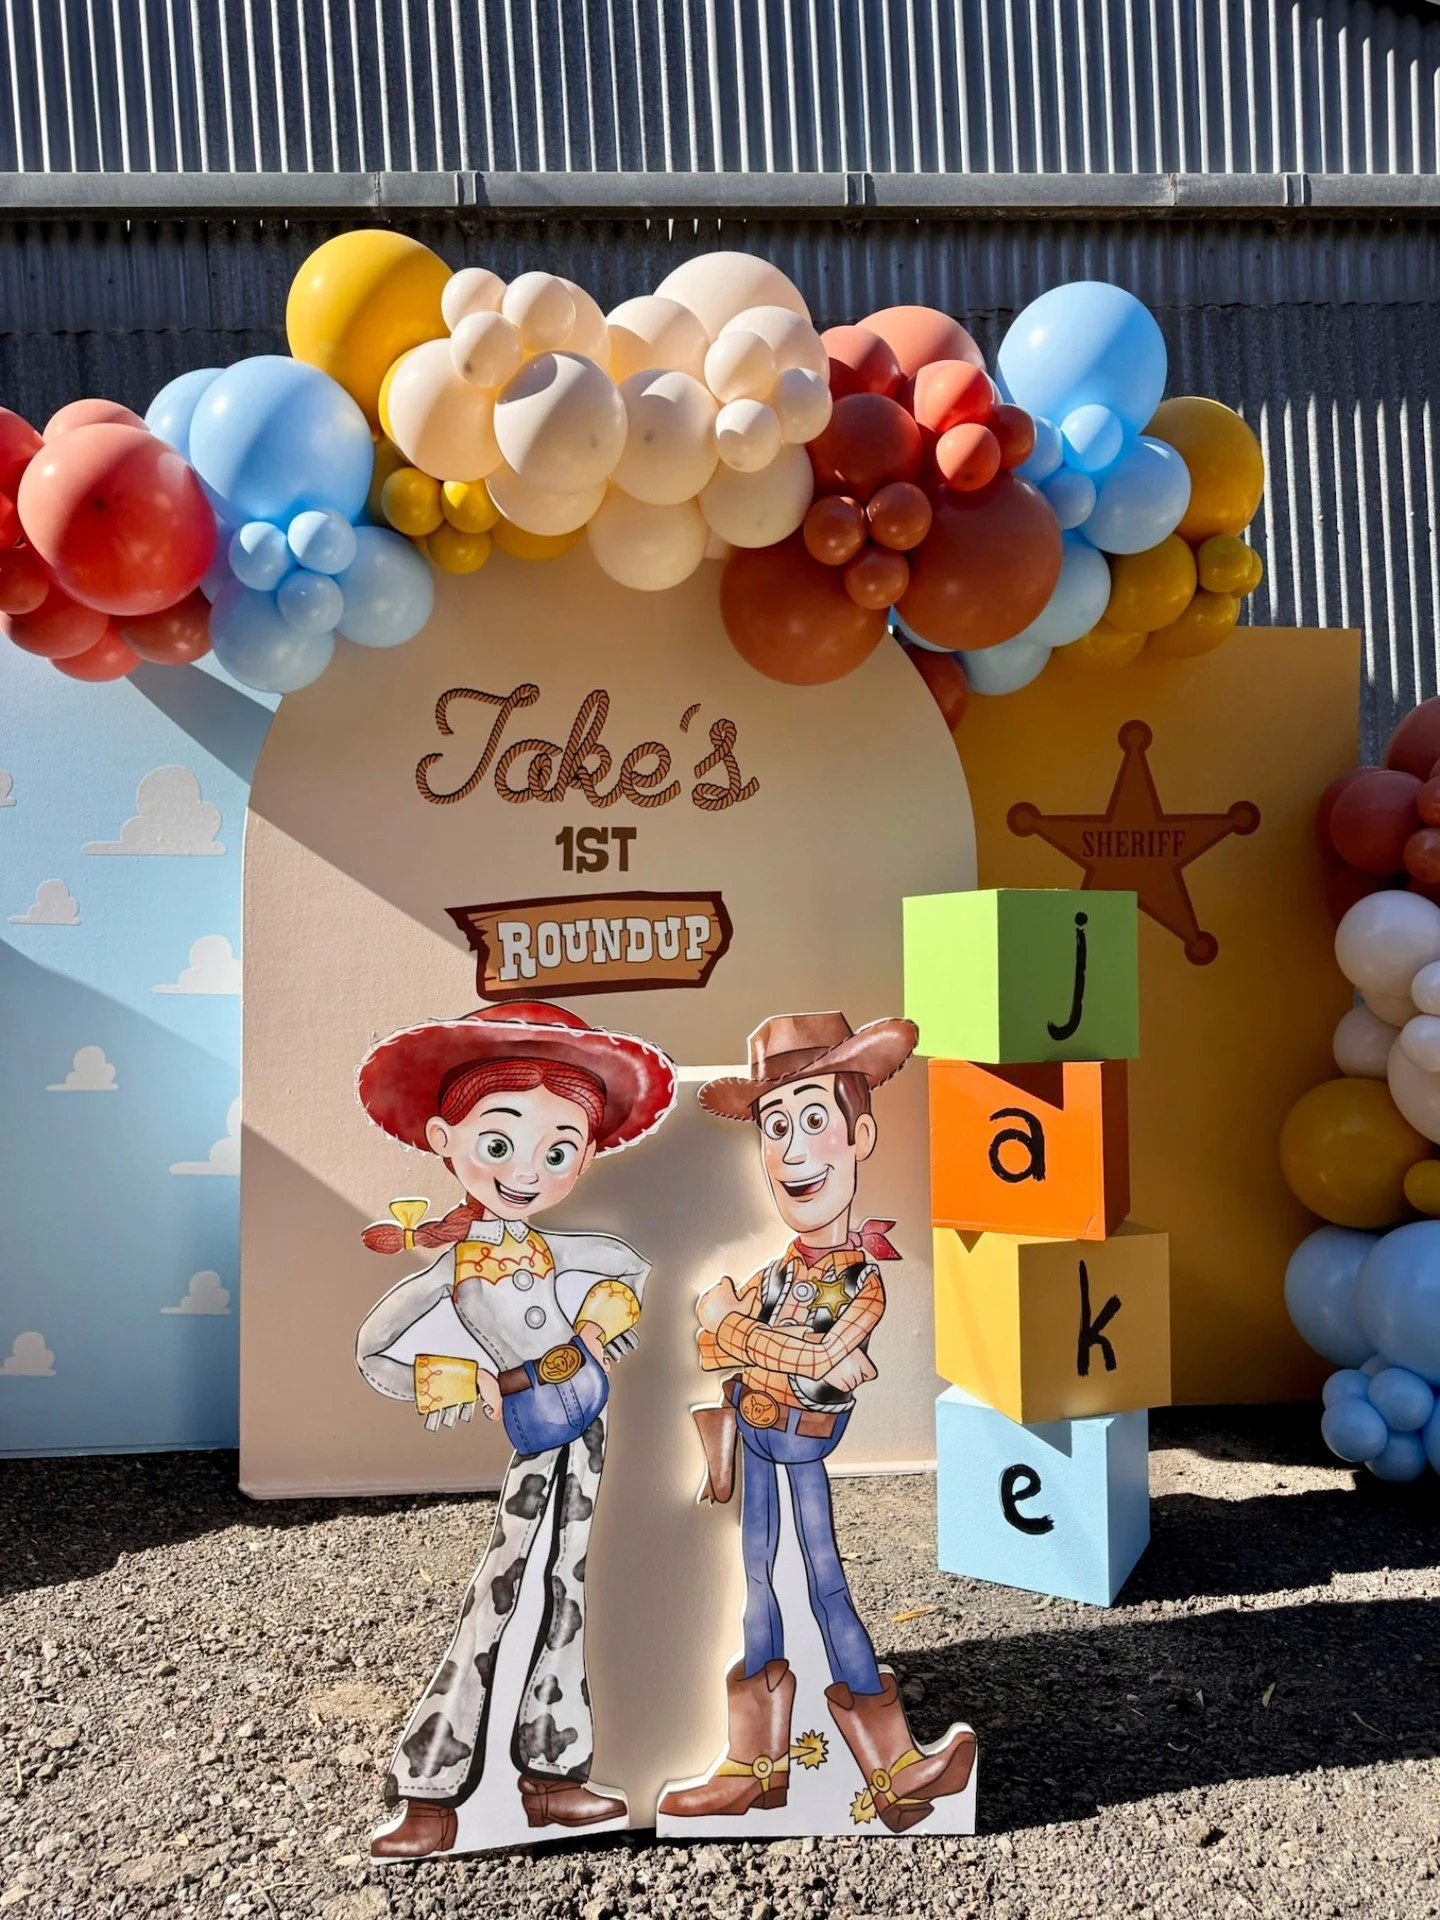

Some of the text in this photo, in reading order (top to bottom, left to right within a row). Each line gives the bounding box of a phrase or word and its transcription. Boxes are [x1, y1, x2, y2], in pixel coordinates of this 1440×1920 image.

[415, 683, 760, 811] Jake's
[555, 826, 637, 874] 1ST
[1080, 829, 1187, 859] SHERIFF
[497, 914, 711, 981] ROUNDUP
[1047, 911, 1089, 1041] j
[988, 1107, 1046, 1184] a
[1076, 1259, 1122, 1377] k
[1000, 1463, 1054, 1535] e
